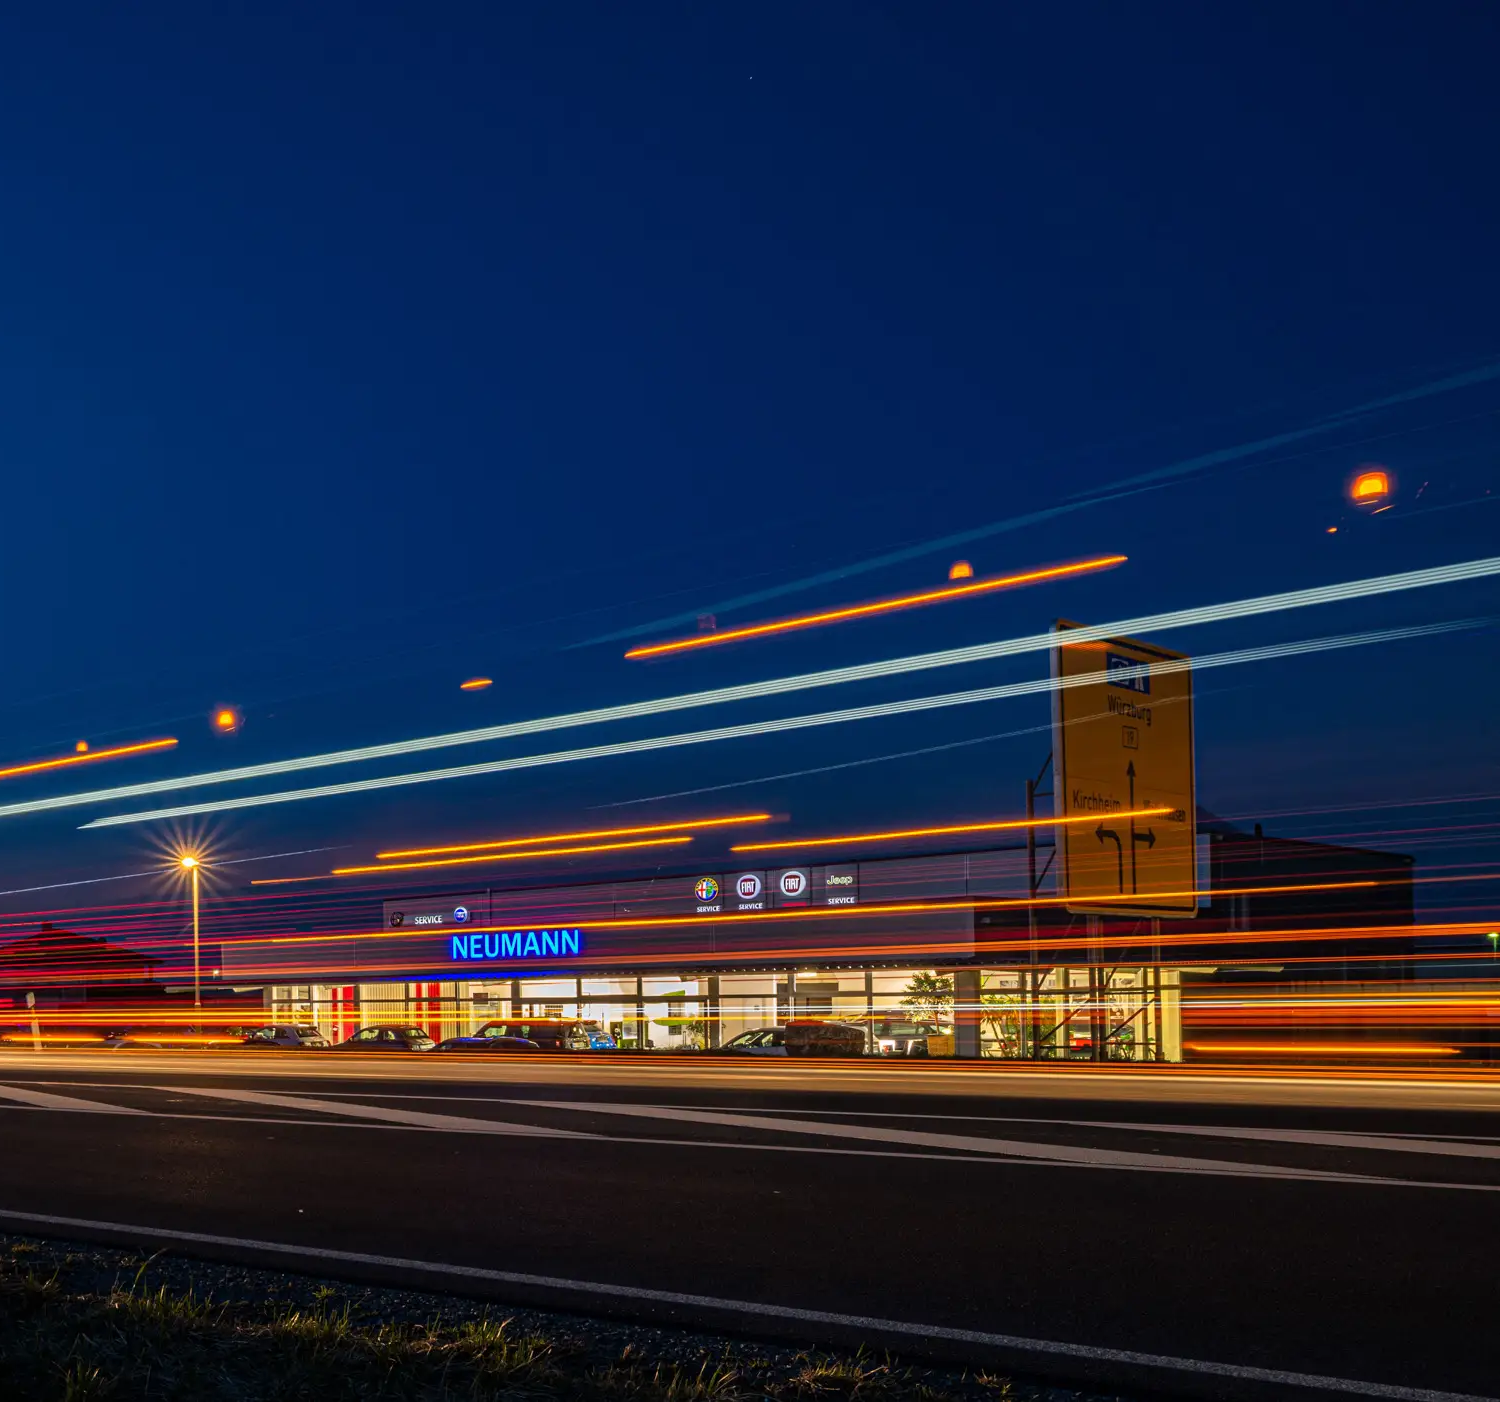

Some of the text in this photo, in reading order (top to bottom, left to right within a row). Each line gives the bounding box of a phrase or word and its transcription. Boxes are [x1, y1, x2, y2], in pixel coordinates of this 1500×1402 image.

[1108, 695, 1151, 726] Würzburg
[1073, 789, 1121, 812] Kirchheim
[785, 877, 799, 890] FIAT
[827, 875, 853, 885] Jeep
[741, 881, 755, 893] FIAT
[828, 897, 855, 905] SERVICE
[414, 915, 443, 924] SERVICE
[452, 929, 579, 959] NEUMANN
